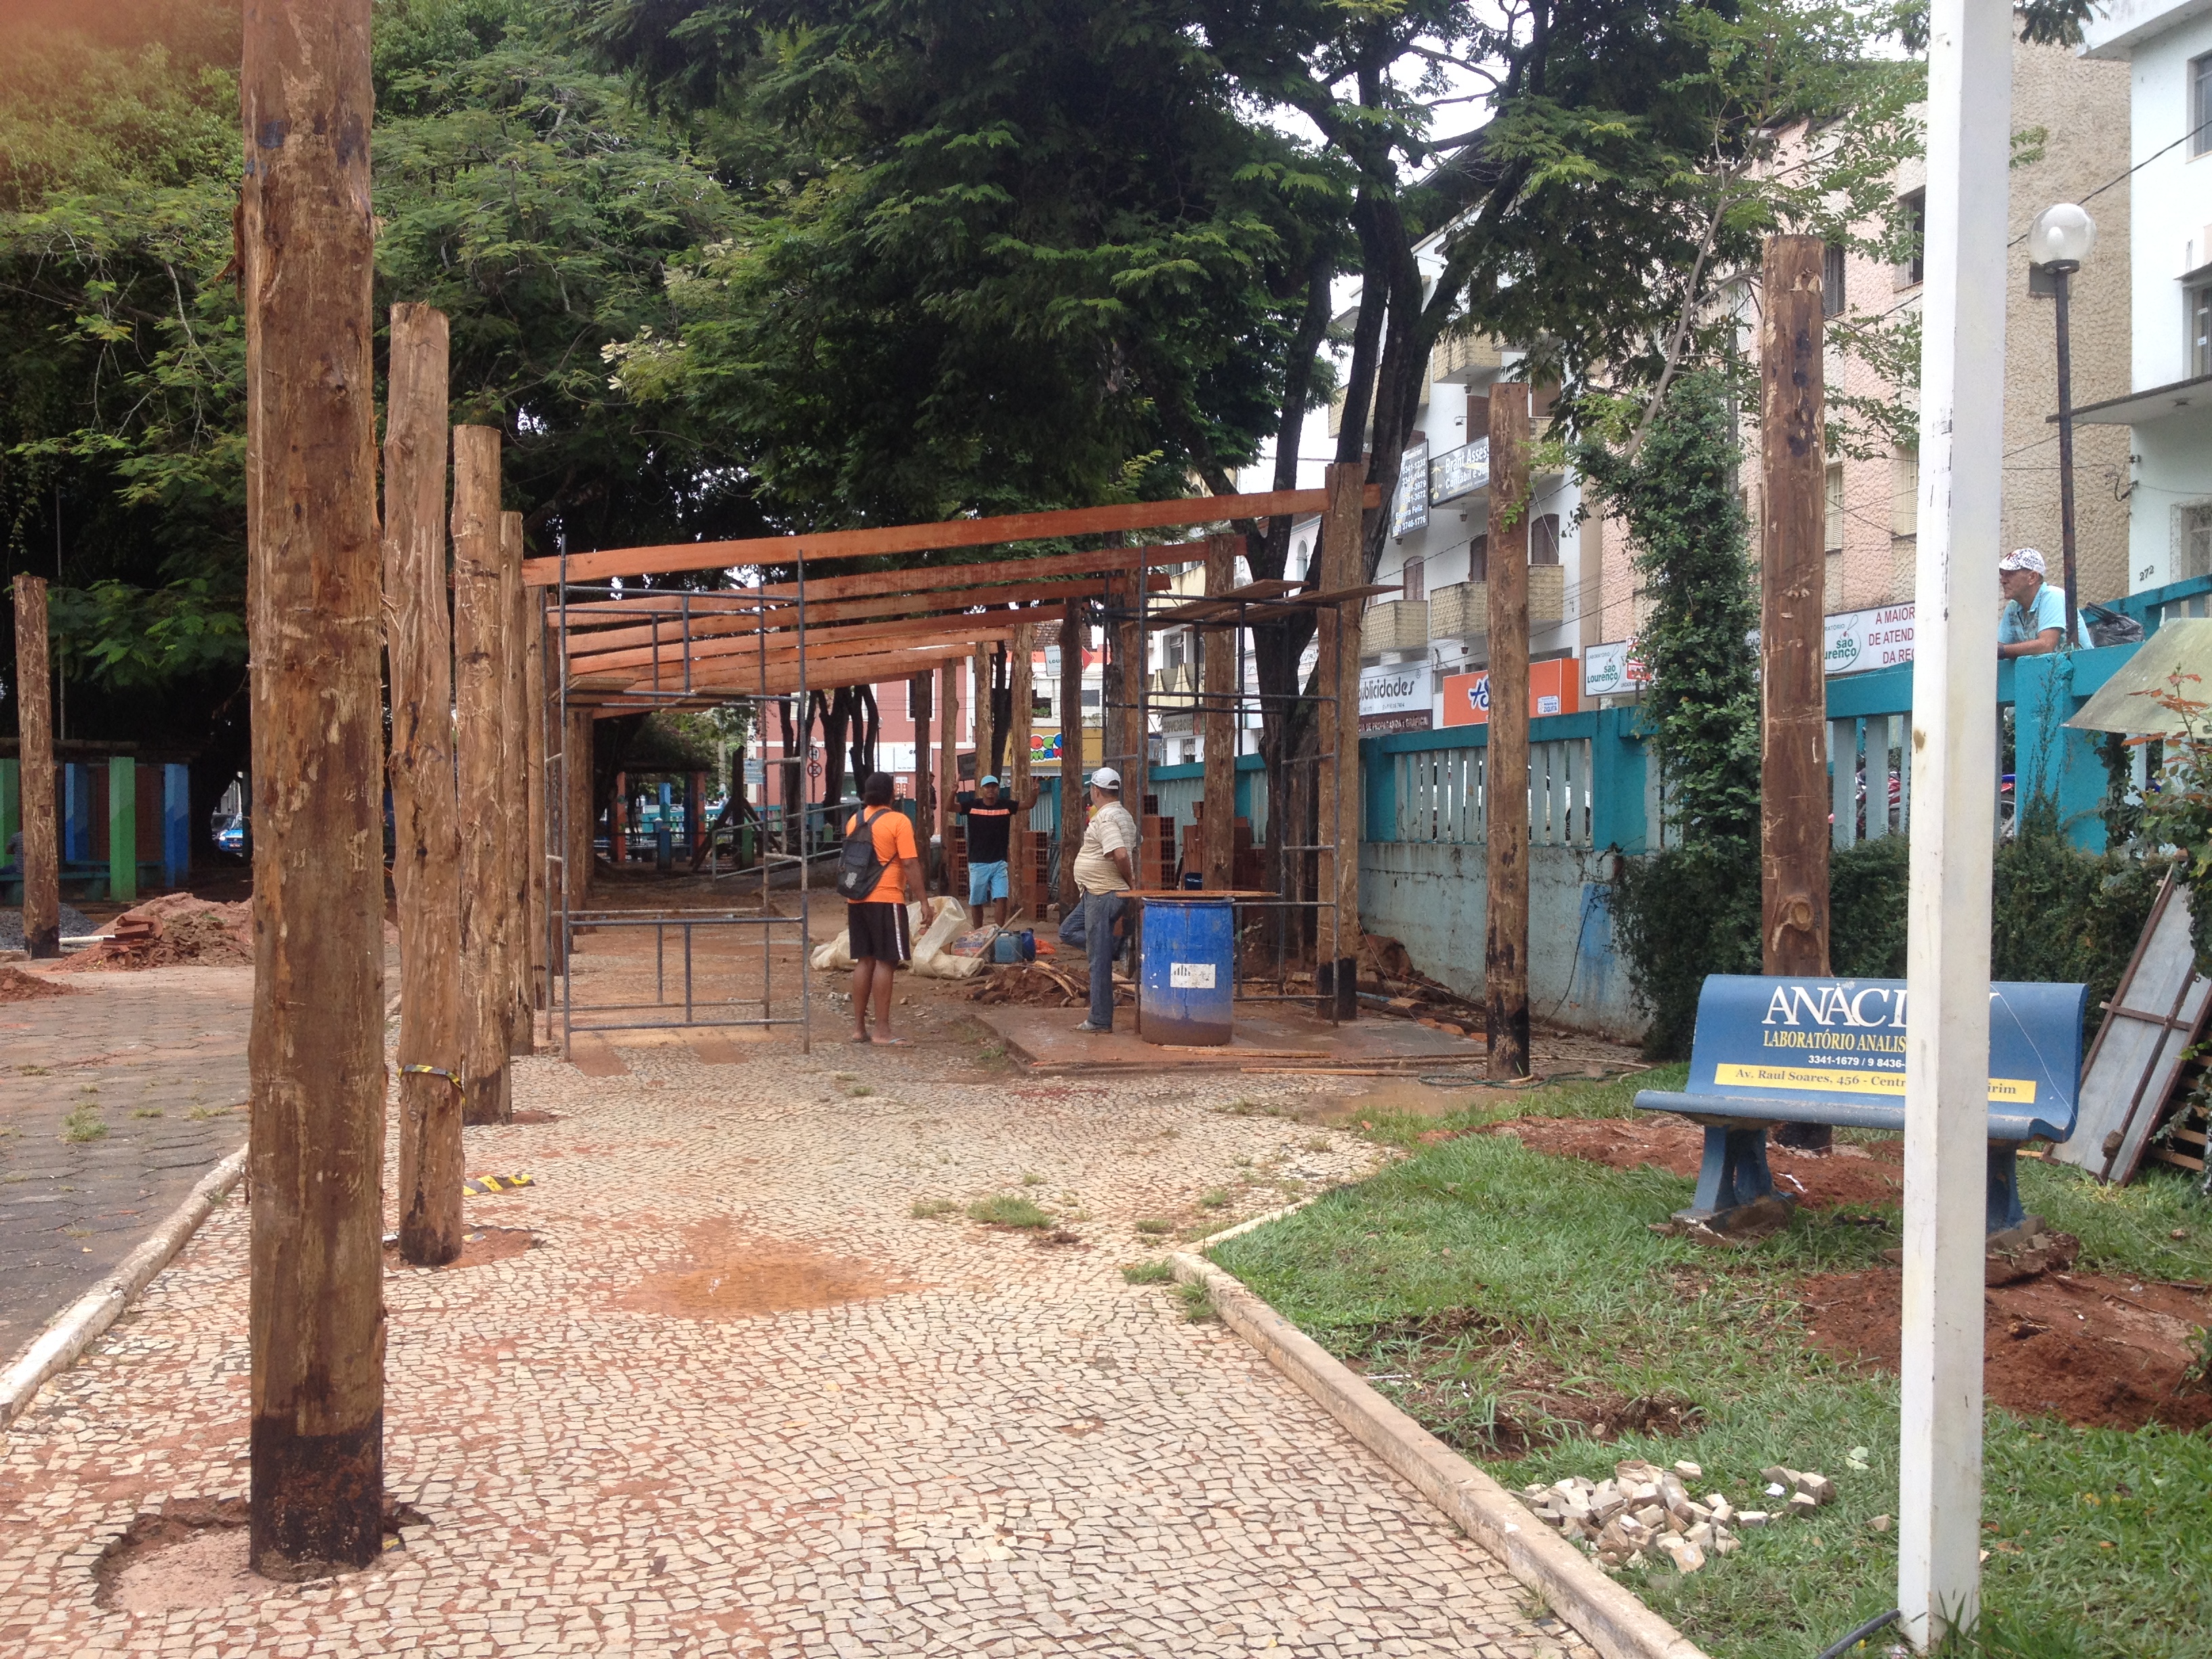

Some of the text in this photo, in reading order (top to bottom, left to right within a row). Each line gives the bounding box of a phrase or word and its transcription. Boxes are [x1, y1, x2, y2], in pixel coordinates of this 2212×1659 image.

[1446, 451, 1465, 474] Brant
[1446, 469, 1471, 489] Contábil
[1473, 470, 1477, 478] e
[1875, 607, 1915, 625] A MAIOR
[1868, 628, 1914, 647] DE ATEND
[1824, 647, 1857, 660] urenço
[1883, 651, 1896, 664] DA
[1763, 1029, 1906, 1052] LABORATÓRIO ANALIS
[1808, 1055, 1859, 1066] 3341-1679
[1877, 1058, 1906, 1067] 8436-
[1736, 1069, 1754, 1078] Av.
[1758, 1069, 1785, 1080] Raul
[1837, 1075, 1860, 1086] 456
[1870, 1076, 1906, 1088] Centr
